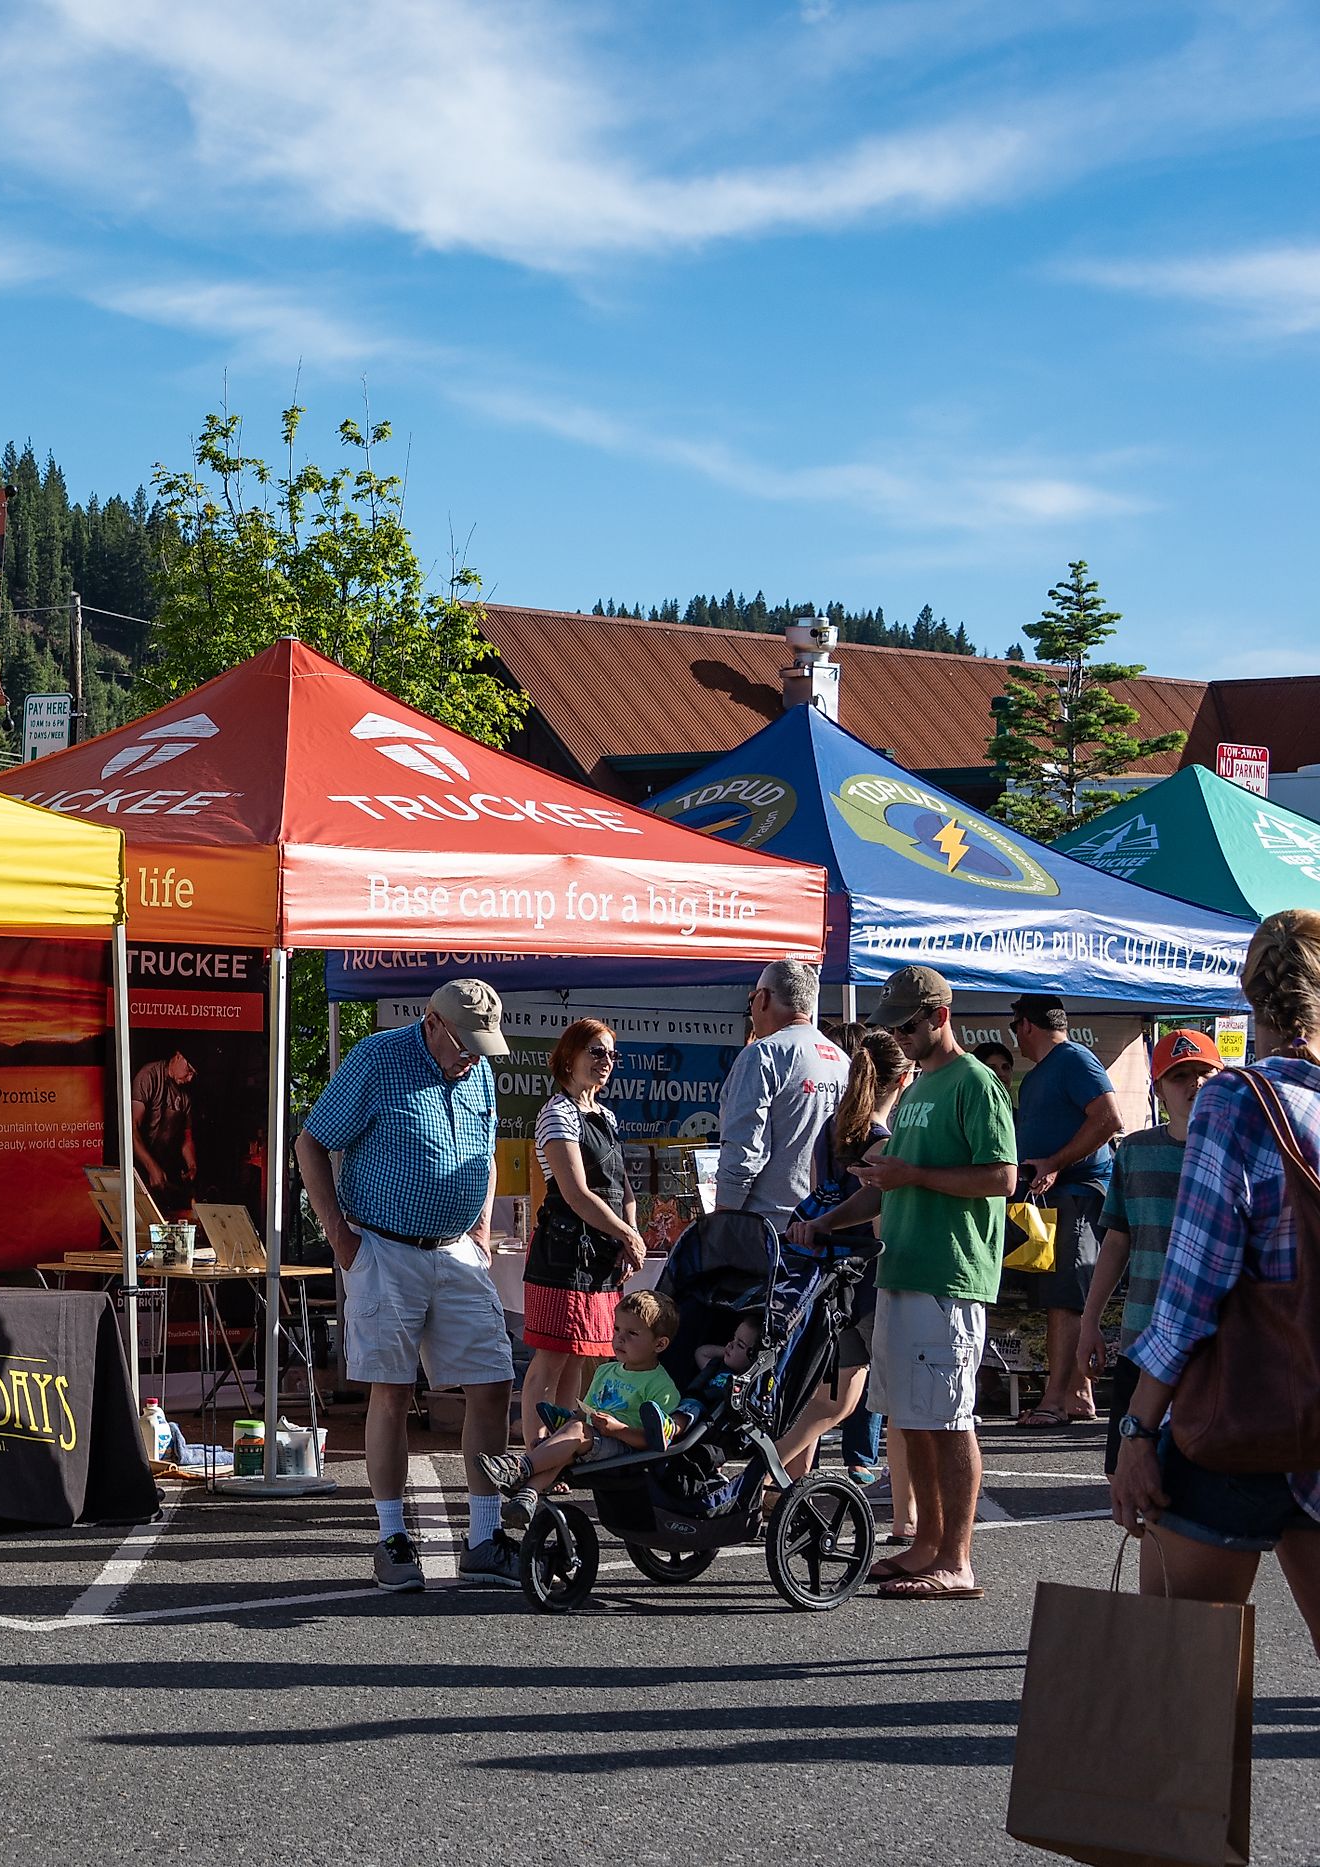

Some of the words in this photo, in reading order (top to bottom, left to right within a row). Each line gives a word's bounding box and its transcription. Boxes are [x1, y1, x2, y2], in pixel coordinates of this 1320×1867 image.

[28, 702, 43, 715] PAY
[47, 702, 68, 714] HERE
[1223, 747, 1263, 759] TOW-AWAY
[1220, 757, 1232, 776] NO
[1235, 763, 1265, 779] PARKING
[675, 780, 786, 810] TDPUD
[847, 780, 948, 813] TDPUD
[326, 793, 645, 834] TRUCKEE
[139, 868, 195, 909] life
[366, 874, 449, 918] Base
[459, 886, 558, 930] camp
[564, 881, 614, 922] for
[622, 895, 640, 923] a
[647, 886, 698, 936] big
[706, 889, 757, 923] life
[862, 926, 954, 950] TRUCKEE
[962, 930, 1045, 955] DONNER
[1052, 932, 1118, 963] PUBLIC
[1124, 936, 1196, 975] UTILITY
[127, 950, 247, 979] TRUCKEE
[130, 1003, 189, 1016] CULTURAL
[191, 1005, 242, 1018] DISTRICT
[668, 1022, 734, 1036] DISTRICT
[494, 1055, 504, 1065] &
[494, 1073, 555, 1096] ONEY
[599, 1080, 646, 1100] SAVE
[34, 1122, 59, 1132] town
[618, 1120, 660, 1133] Account
[28, 1138, 56, 1148] world
[59, 1137, 80, 1148] class
